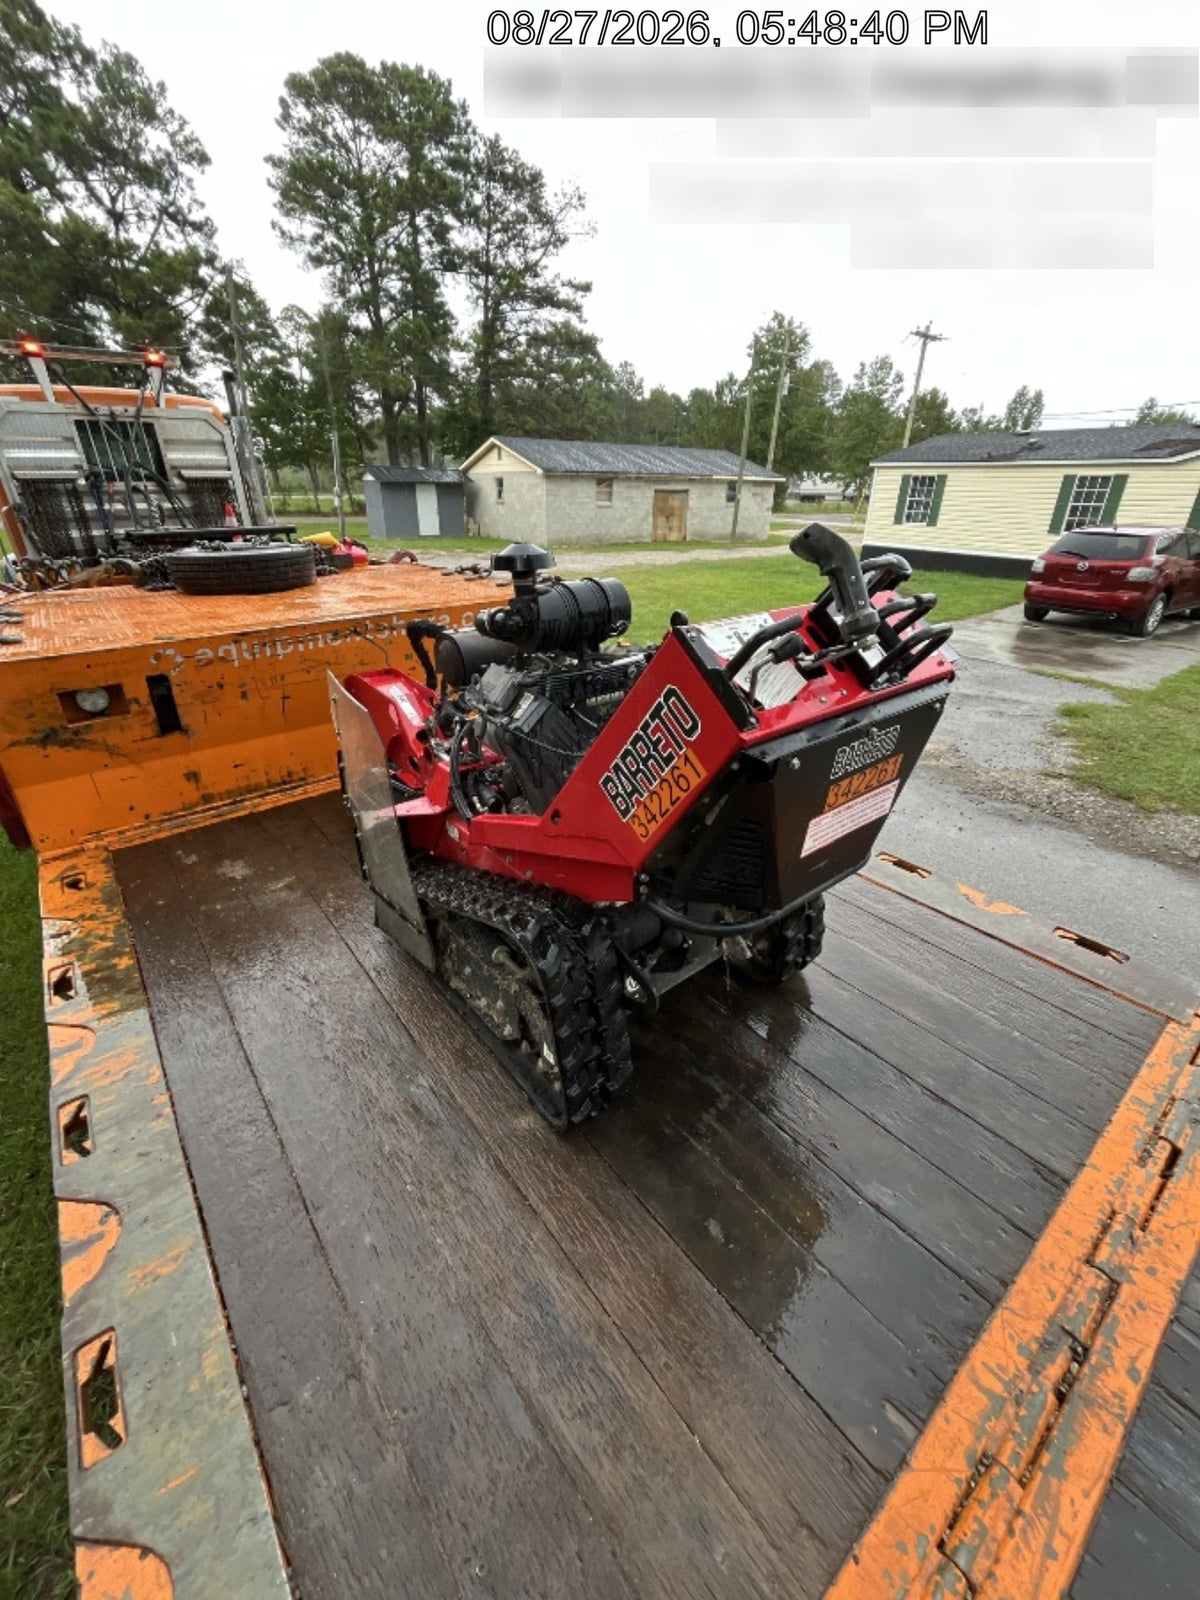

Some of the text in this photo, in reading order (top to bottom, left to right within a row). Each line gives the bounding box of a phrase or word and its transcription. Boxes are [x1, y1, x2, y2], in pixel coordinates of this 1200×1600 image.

[599, 684, 702, 822] BARRETO
[631, 753, 702, 839] 342261
[825, 753, 902, 810] 342261
